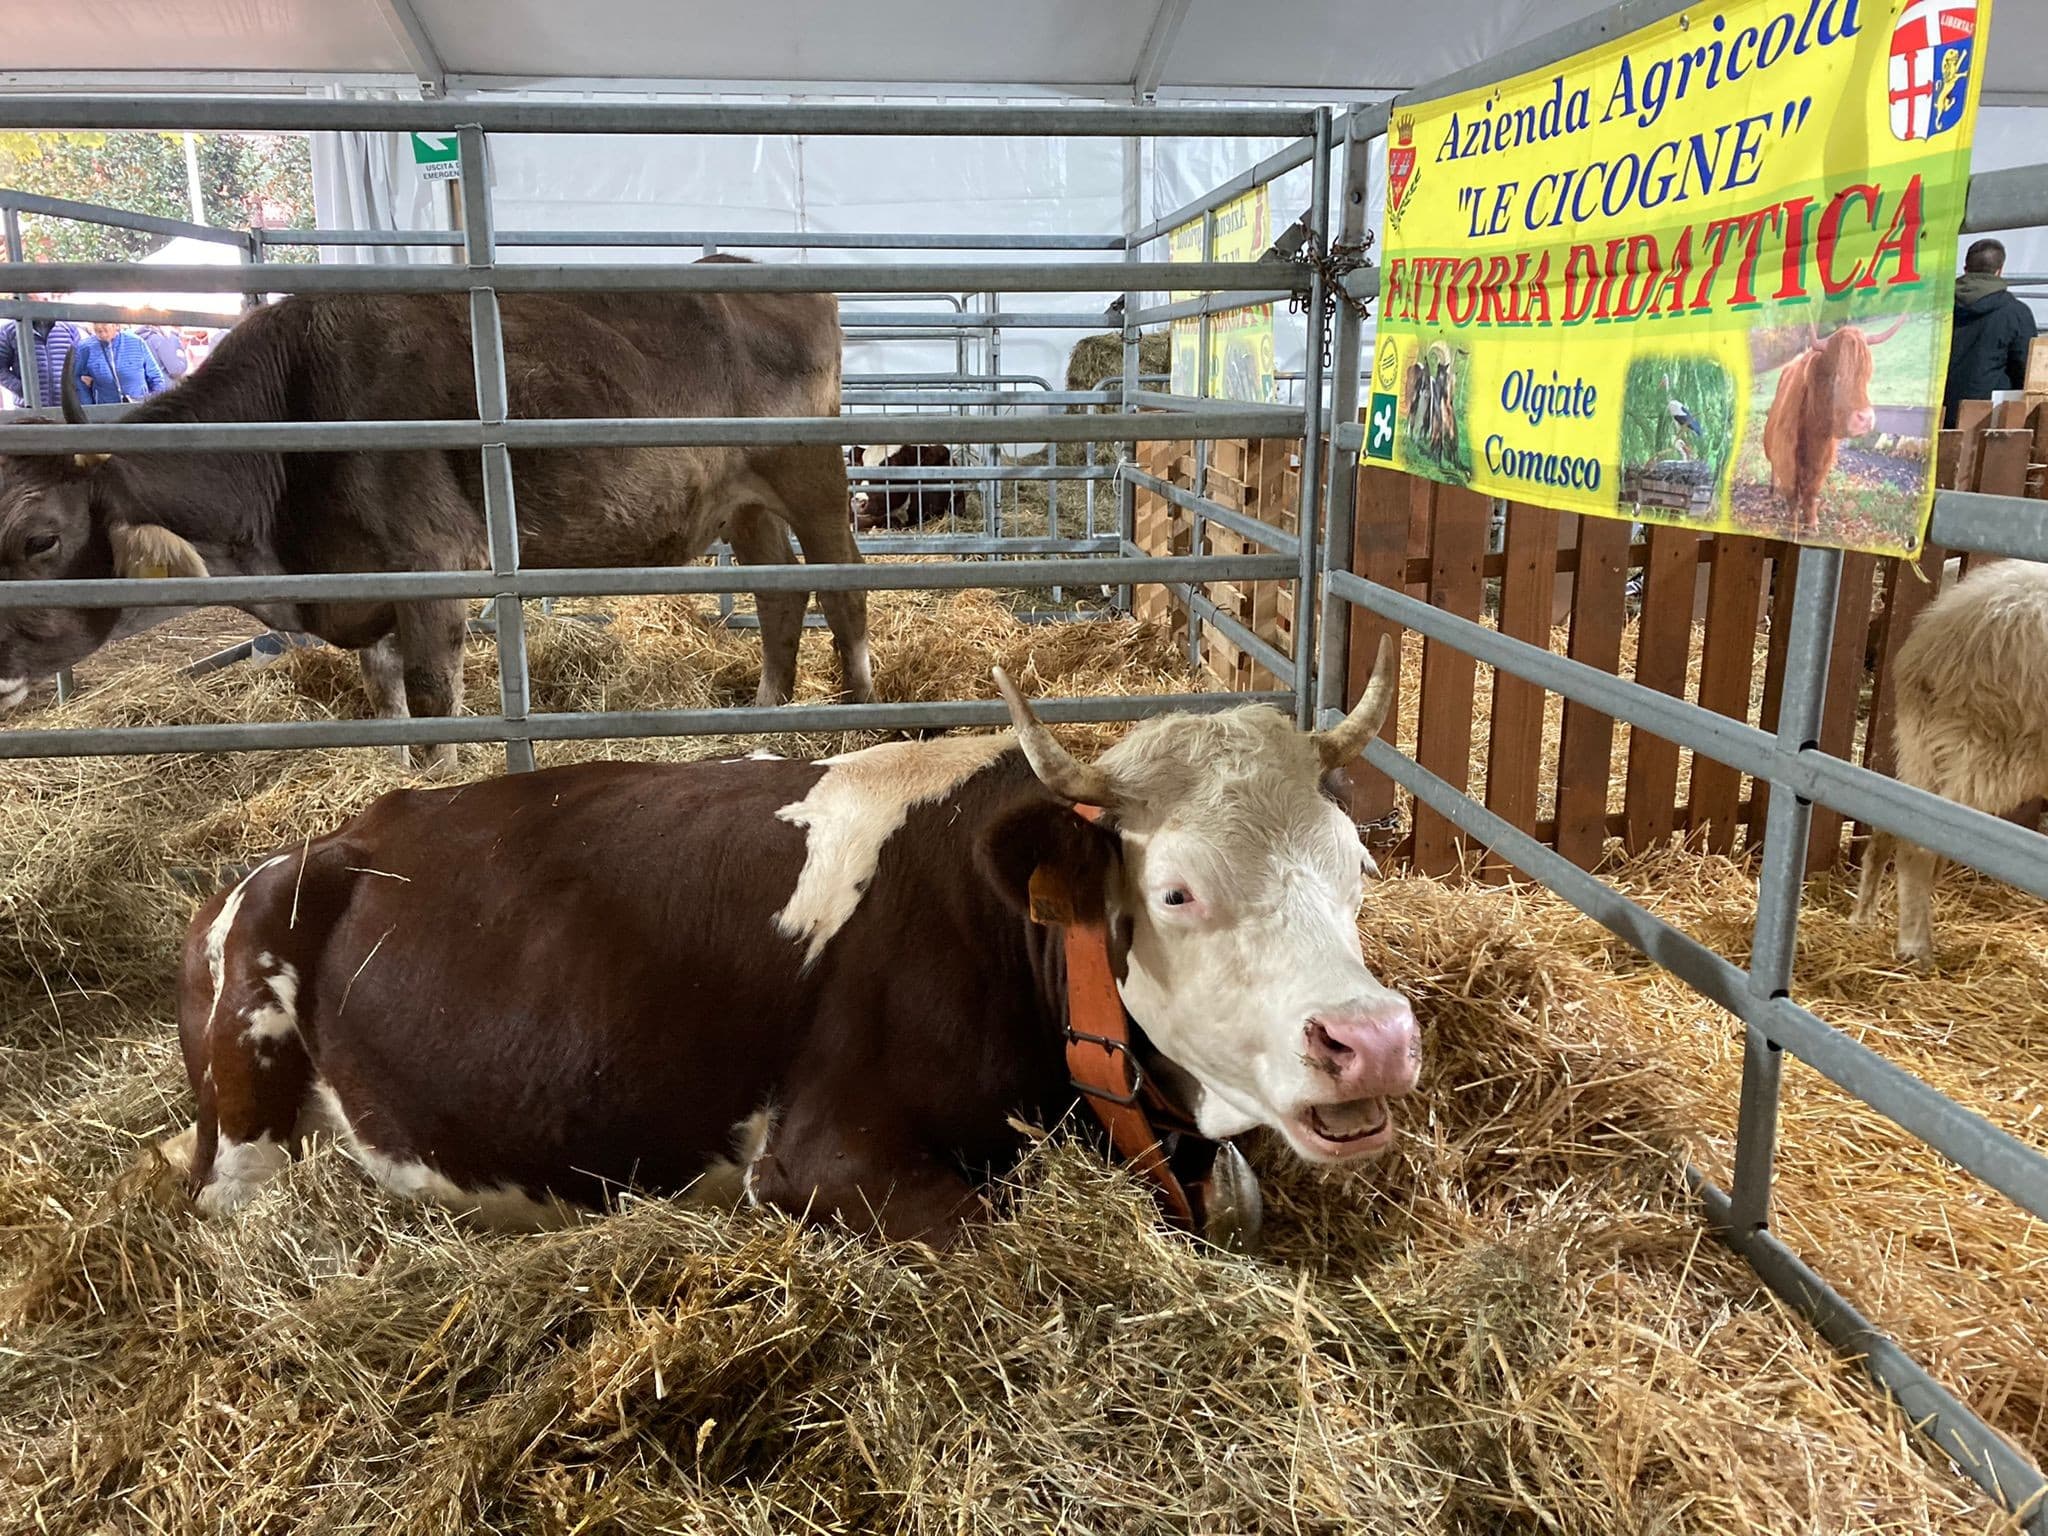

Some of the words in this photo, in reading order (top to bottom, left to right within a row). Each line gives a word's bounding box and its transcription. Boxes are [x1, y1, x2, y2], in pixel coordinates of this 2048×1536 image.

[1435, 78, 1591, 163] Azienda
[1599, 0, 1863, 128] Agricola
[423, 171, 460, 179] EMERGEN
[425, 163, 453, 171] USCITA
[1458, 182, 1520, 238] "LE
[1524, 96, 1812, 231] CICOGNE"
[1384, 250, 1553, 329] FATTORIA
[1560, 173, 1924, 327] DIDATTICA
[1501, 368, 1597, 427] Olgiate
[1485, 434, 1601, 492] Comasco
